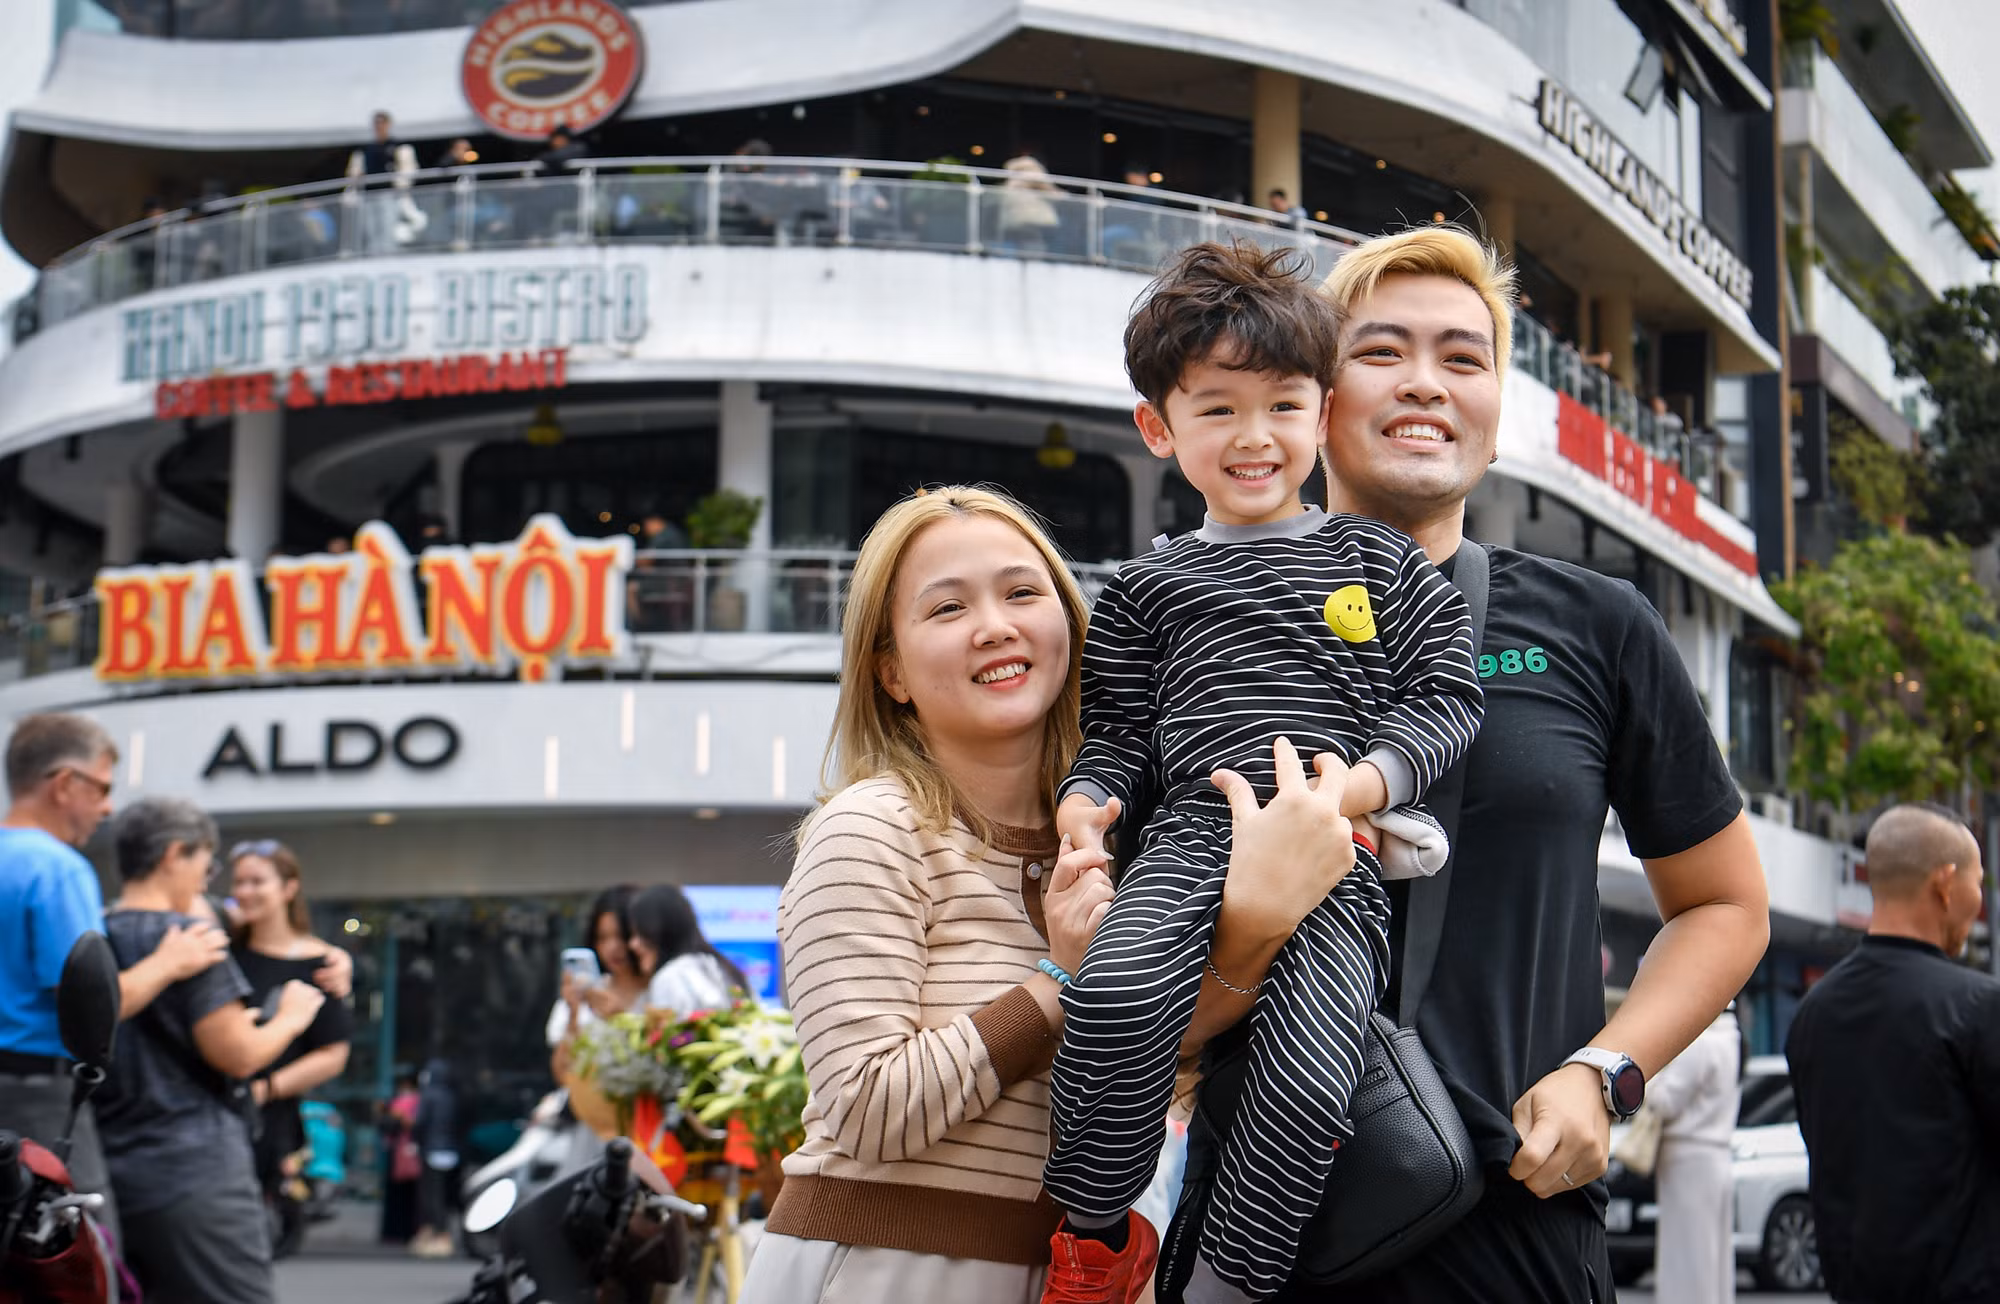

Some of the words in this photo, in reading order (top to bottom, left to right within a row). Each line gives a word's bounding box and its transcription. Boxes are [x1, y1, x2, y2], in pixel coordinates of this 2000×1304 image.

[469, 1, 629, 66] HIGHLANDS
[487, 87, 610, 130] COFFEE
[1540, 78, 1685, 244] HIGHLANDS
[1680, 212, 1754, 312] COFFEE
[283, 273, 411, 362] 1930
[434, 263, 650, 347] BISTRO
[155, 371, 279, 421] COFFEE
[324, 347, 570, 406] RESTAURANT
[95, 566, 258, 683] BIA
[264, 529, 414, 673] HÀ
[420, 525, 620, 683] NỘI
[1477, 646, 1548, 679] 986
[201, 714, 463, 780] ALDO
